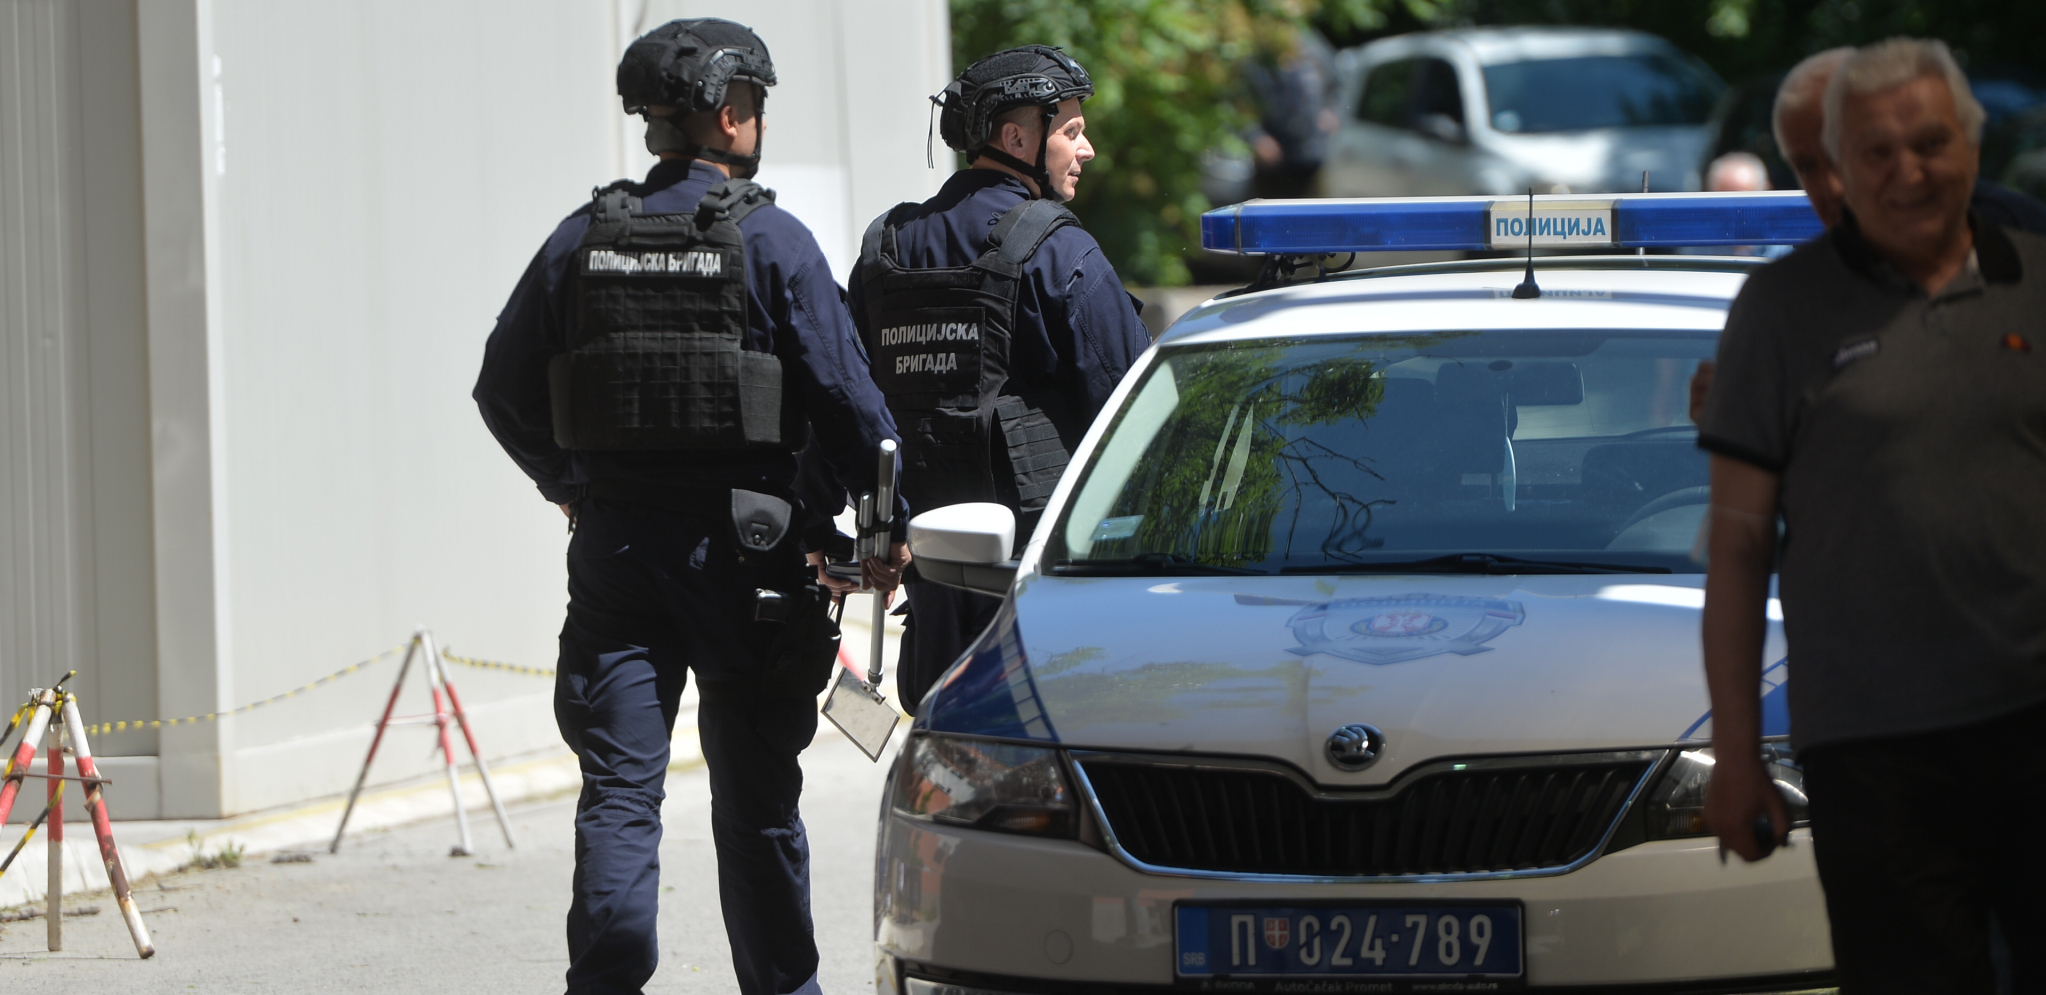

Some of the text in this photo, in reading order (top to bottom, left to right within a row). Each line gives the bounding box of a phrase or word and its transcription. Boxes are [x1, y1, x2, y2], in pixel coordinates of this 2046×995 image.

[1496, 217, 1606, 240] ПОЛИЦИЈА
[588, 250, 722, 277] ПОЛИЦИЈСКА БРИГАДА
[881, 322, 979, 347] ПОЛИЦИЈСКА
[895, 352, 958, 375] БРИГАДА
[1183, 952, 1206, 966] SRB
[1345, 980, 1393, 993] Promet
